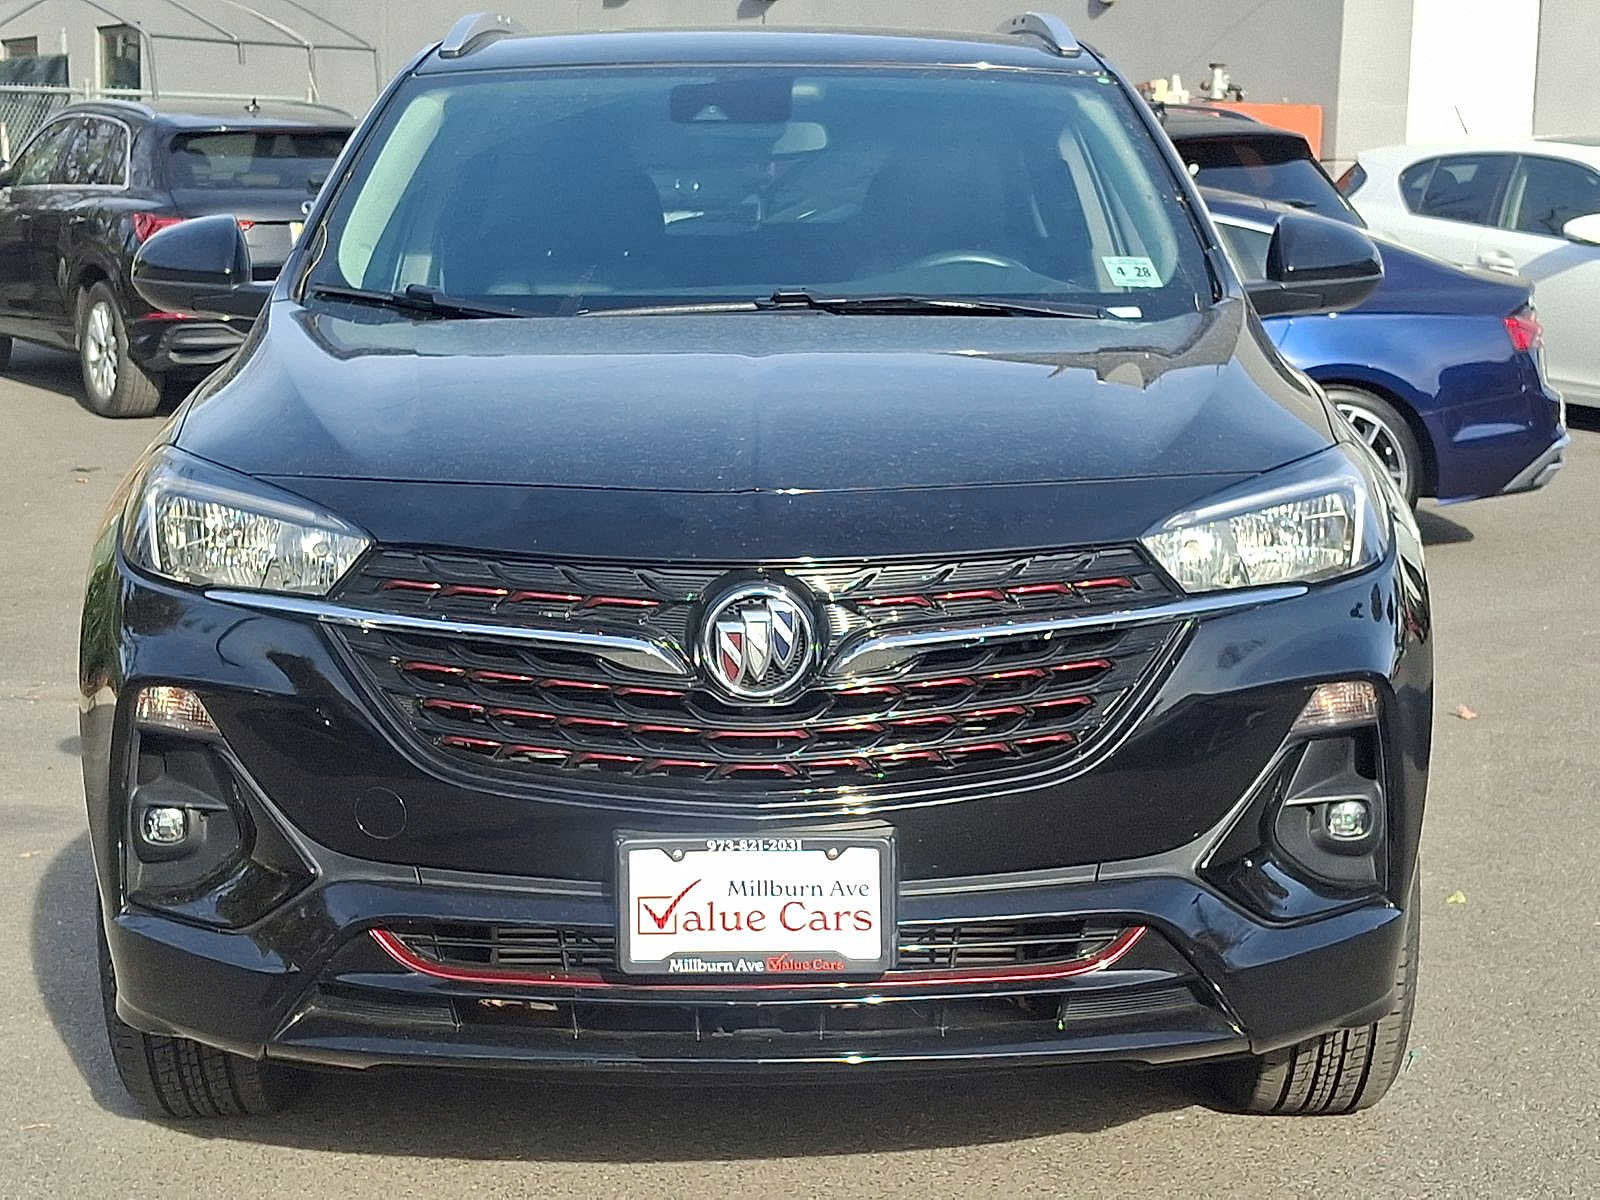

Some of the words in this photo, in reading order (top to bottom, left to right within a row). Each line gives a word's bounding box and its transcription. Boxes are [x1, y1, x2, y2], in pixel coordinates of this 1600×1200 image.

[1134, 266, 1151, 278] 28
[727, 880, 823, 897] Millburn
[830, 880, 870, 897] Ave
[779, 901, 872, 932] Cars
[668, 958, 735, 972] Millburn
[738, 958, 764, 972] Ave
[812, 959, 844, 970] Cars
